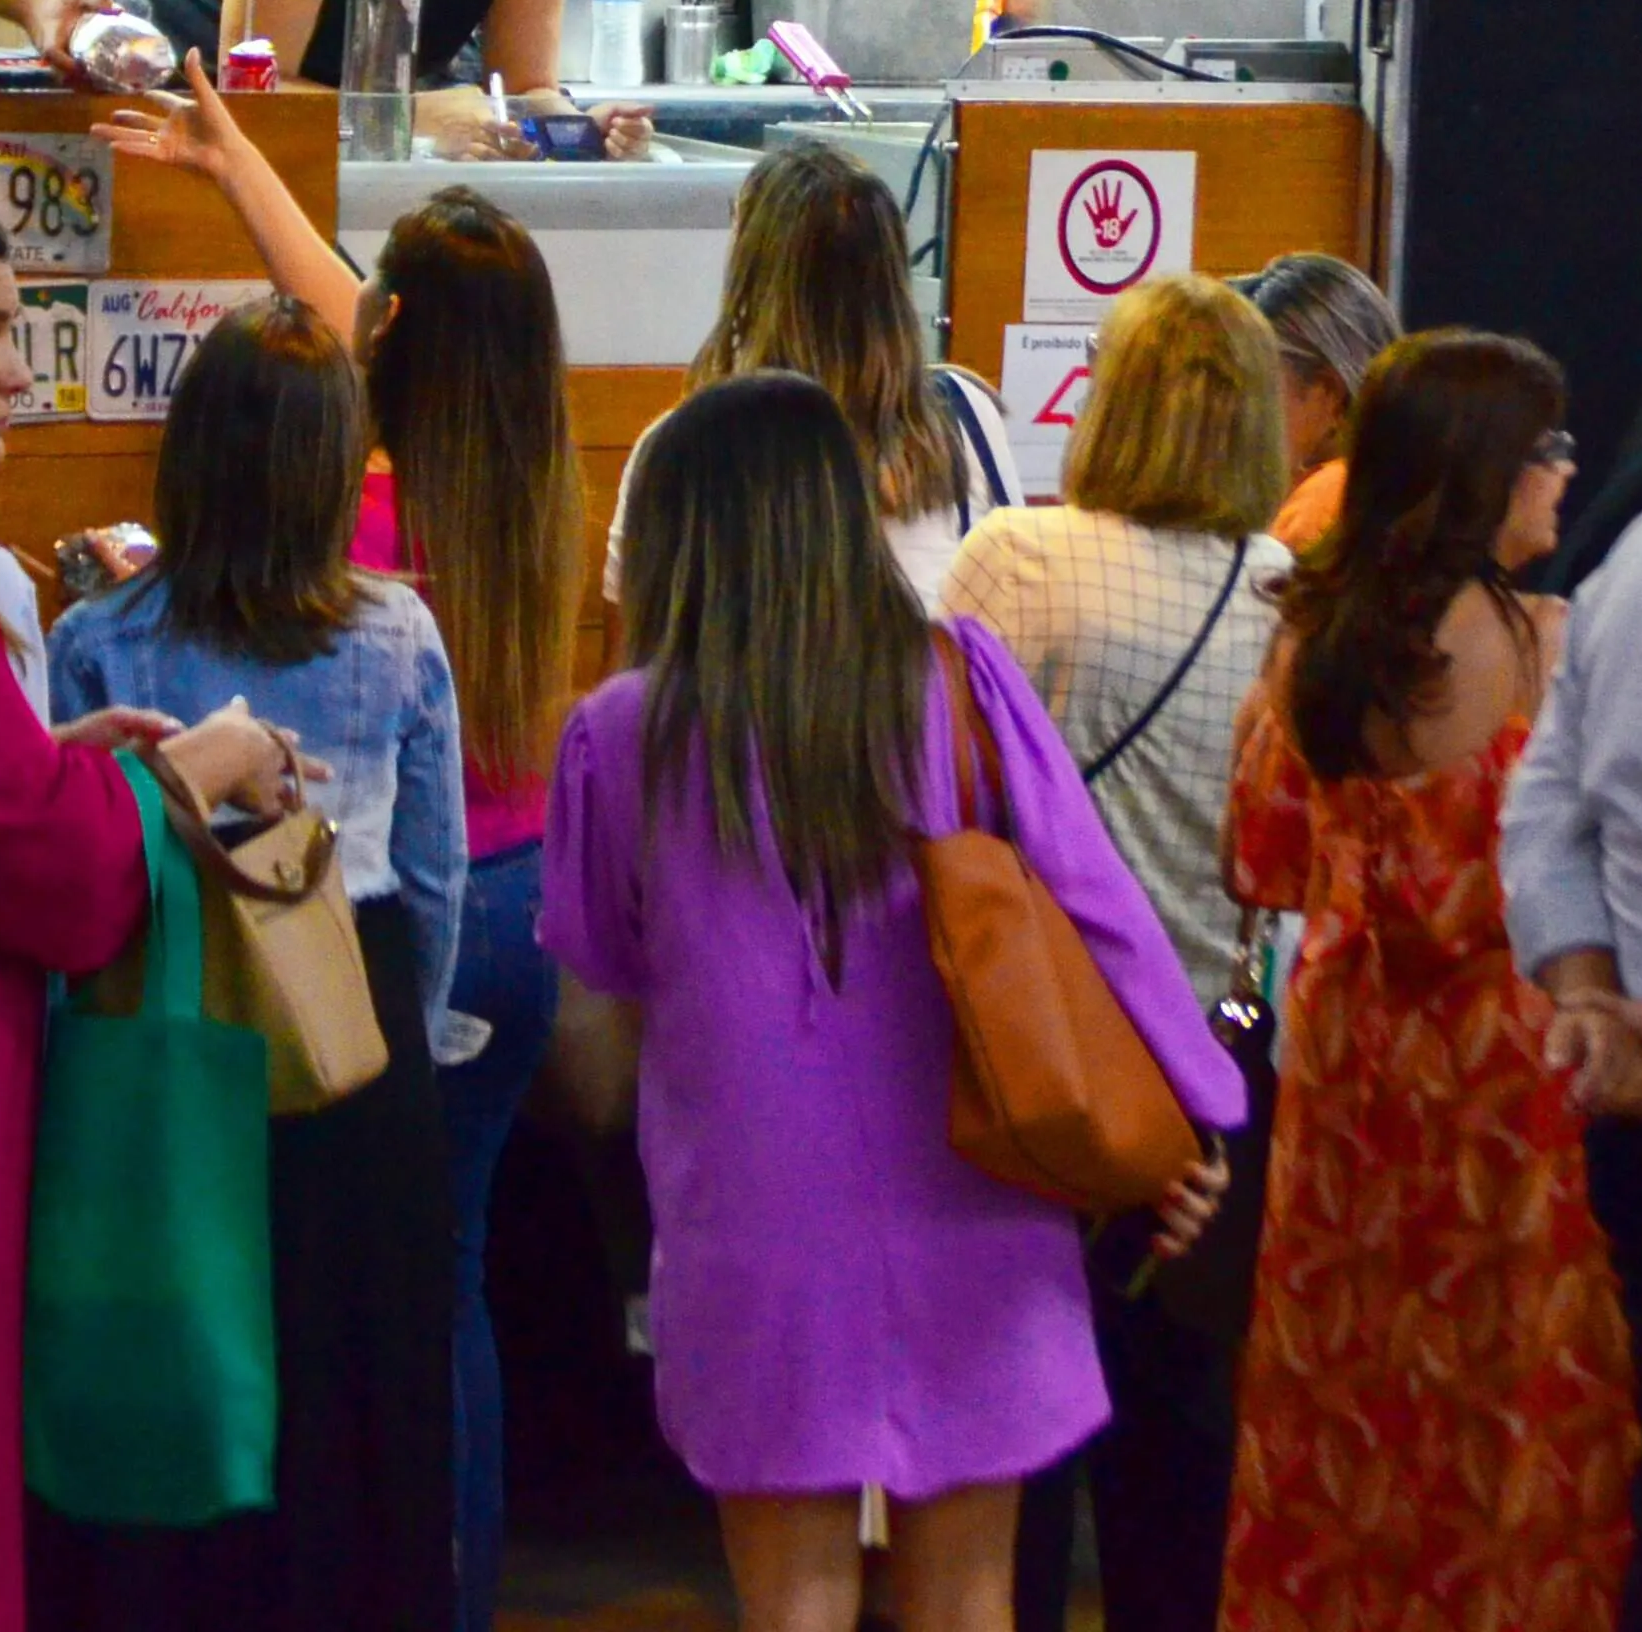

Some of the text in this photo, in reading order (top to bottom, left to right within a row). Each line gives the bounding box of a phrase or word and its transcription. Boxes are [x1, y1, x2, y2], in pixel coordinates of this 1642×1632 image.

[9, 165, 100, 237] 983
[102, 293, 133, 314] AUG
[1030, 336, 1083, 350] proibido
